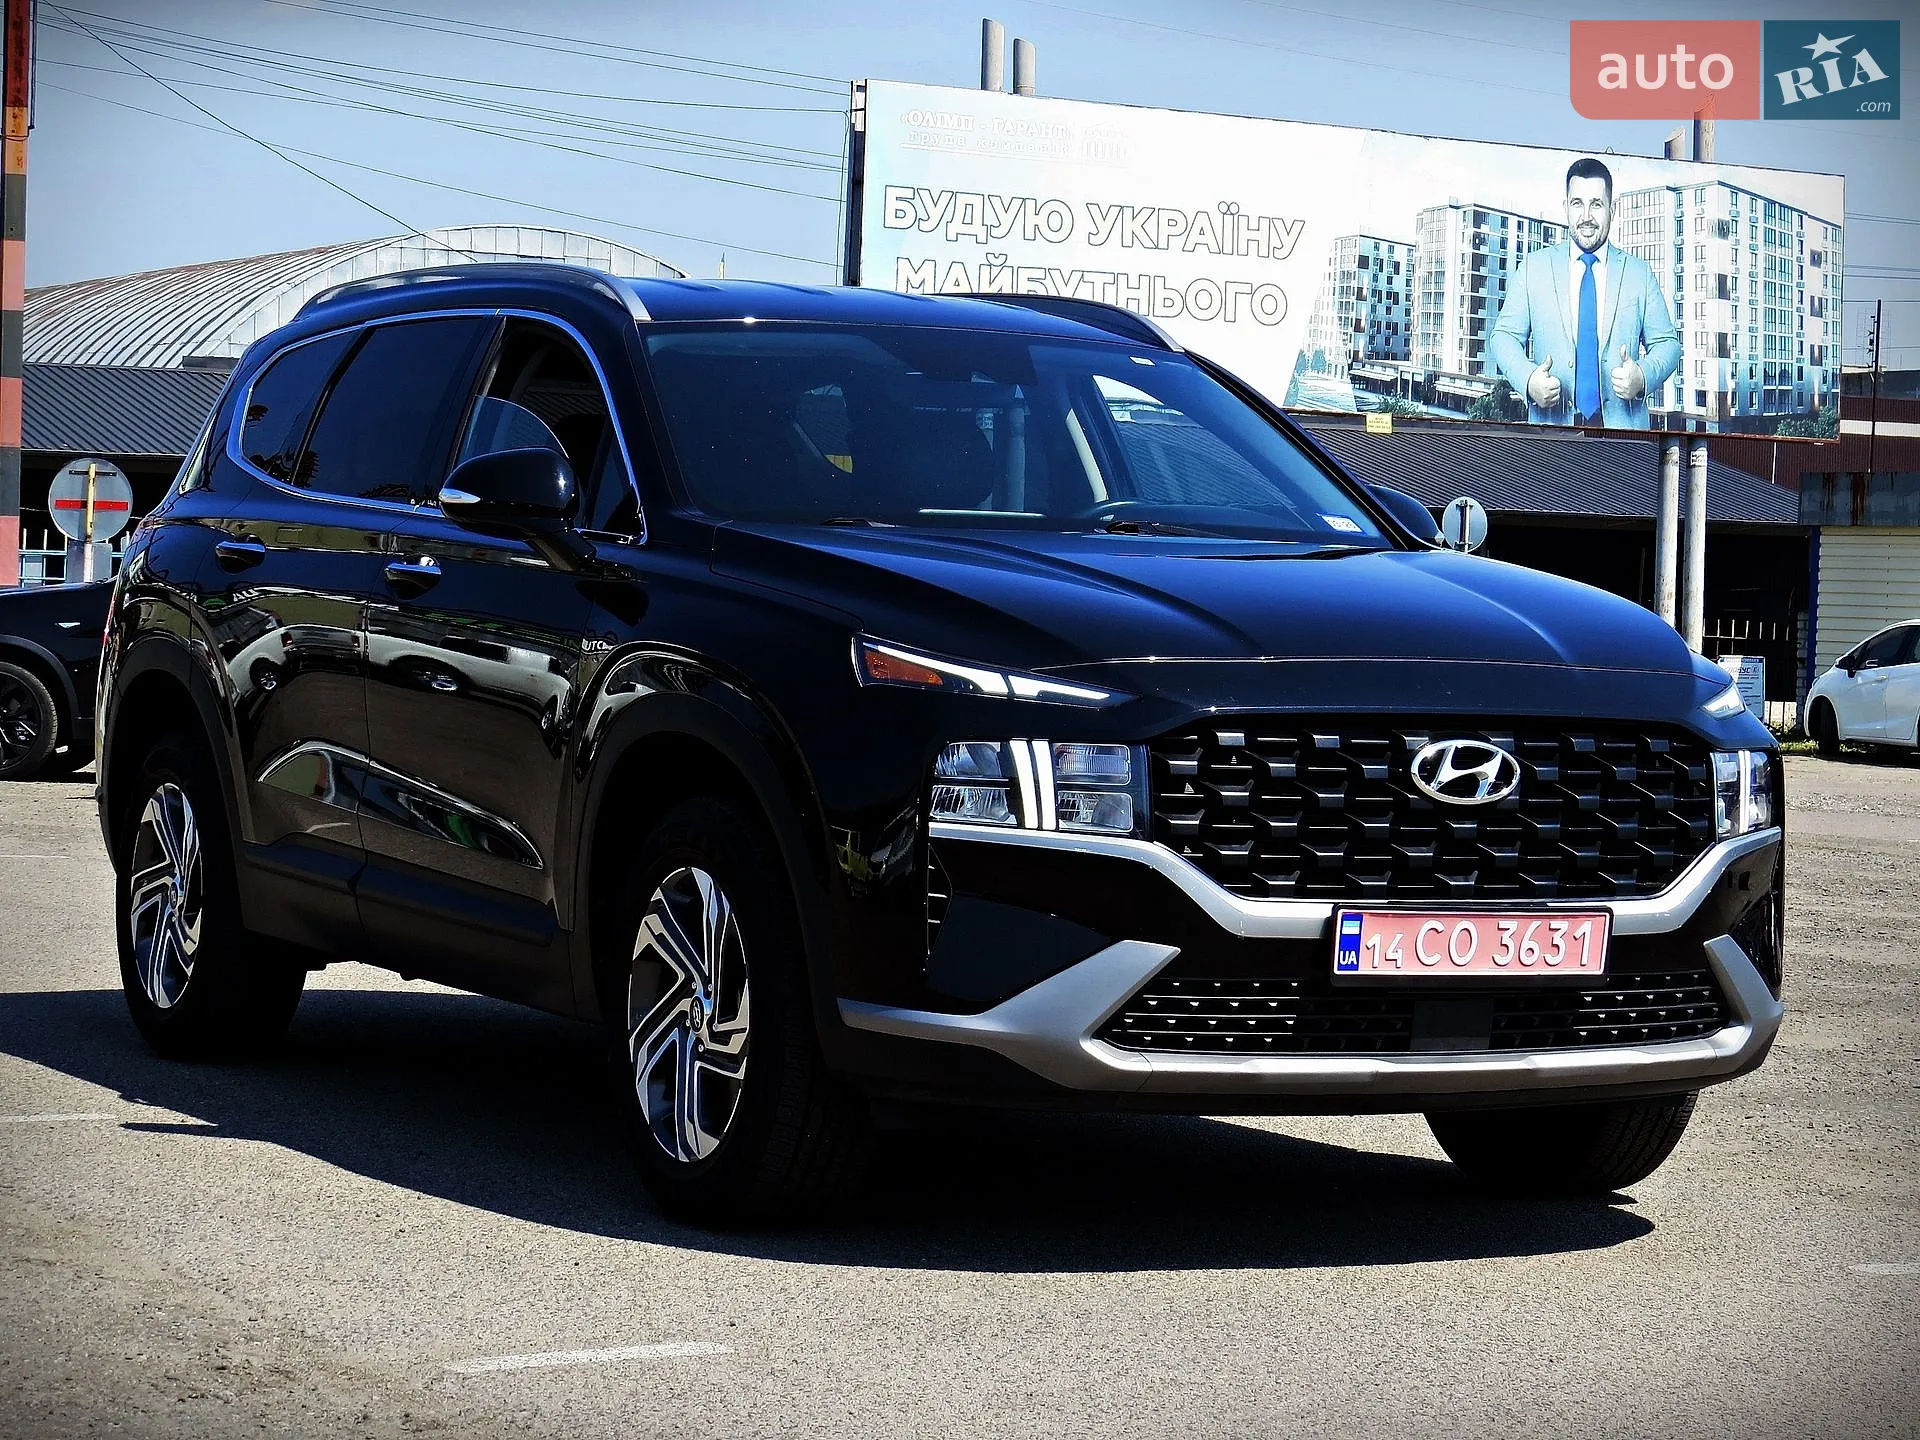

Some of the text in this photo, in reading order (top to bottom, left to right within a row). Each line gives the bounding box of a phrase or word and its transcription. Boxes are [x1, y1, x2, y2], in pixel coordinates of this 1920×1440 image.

[883, 184, 1306, 261] БУДУЮ УКРАЇНУ
[895, 252, 1289, 326] МАЙБУТНЬОГО
[1339, 950, 1358, 966] UA
[1365, 919, 1594, 968] 14 CO 3631
